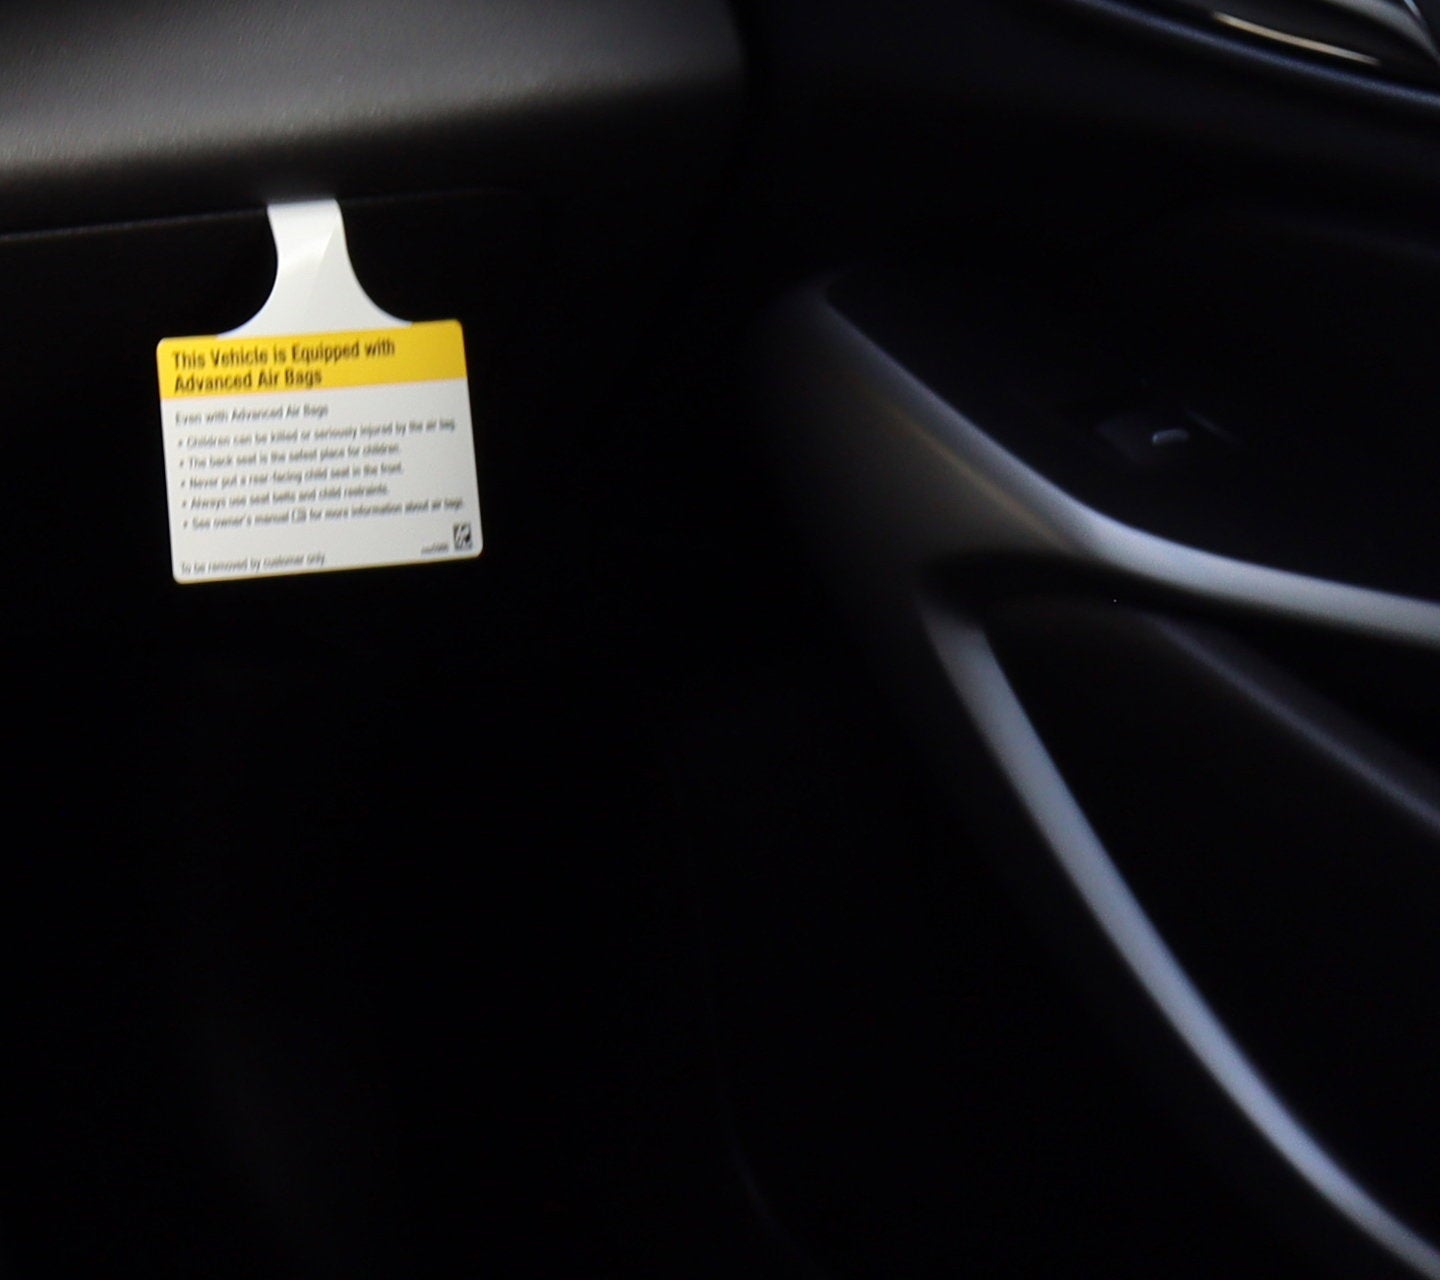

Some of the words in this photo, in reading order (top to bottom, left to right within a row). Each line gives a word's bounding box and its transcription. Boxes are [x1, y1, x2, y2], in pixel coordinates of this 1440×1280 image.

[174, 350, 206, 371] This
[211, 346, 269, 367] Vehicle
[274, 345, 287, 364] is
[291, 341, 360, 366] Equipped
[365, 337, 396, 358] with
[174, 371, 253, 394] Advanced
[258, 369, 279, 387] Air
[284, 367, 323, 391] Bags
[175, 409, 202, 426] Even
[205, 407, 229, 424] with
[231, 404, 284, 423] Advanced
[286, 403, 301, 419] Air
[303, 402, 329, 421] Bags
[191, 495, 226, 511] Always
